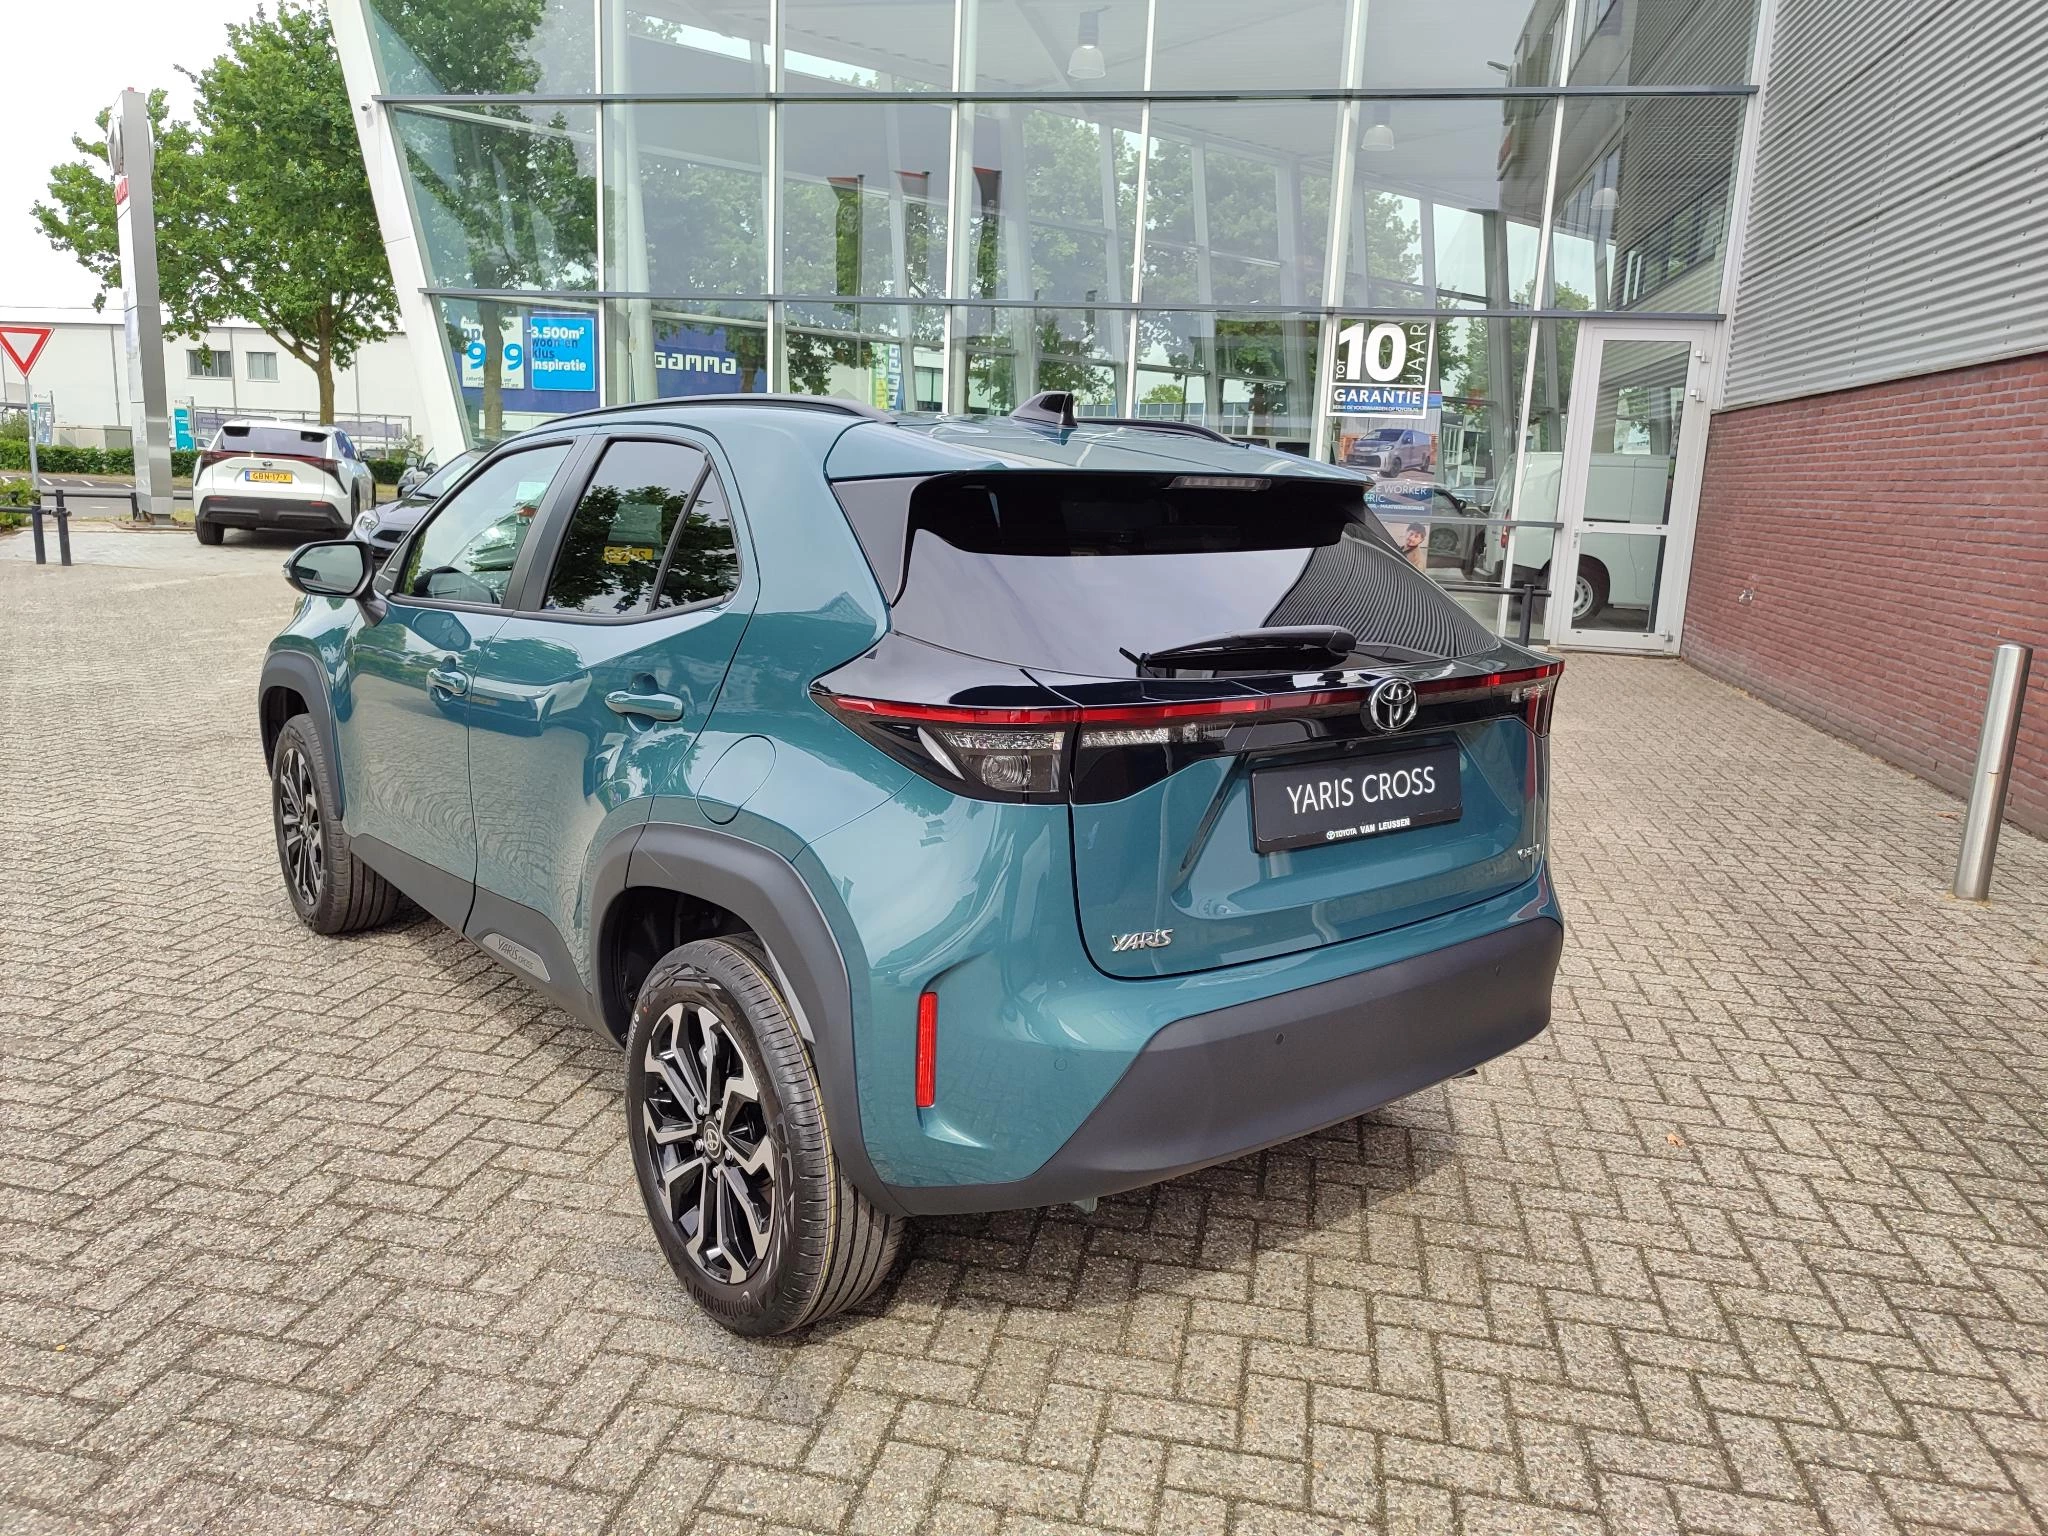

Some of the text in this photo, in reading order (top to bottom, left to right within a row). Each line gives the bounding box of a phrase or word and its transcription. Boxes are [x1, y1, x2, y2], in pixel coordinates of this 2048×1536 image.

[1339, 323, 1406, 382] 10
[1405, 324, 1427, 383] JAAR
[532, 359, 587, 372] inspiratie
[1336, 360, 1346, 379] TOT
[1334, 388, 1421, 404] GARANTIE
[1384, 485, 1427, 495] WORKER
[1286, 766, 1436, 815] YARIS CROSS
[1335, 817, 1410, 838] TOYOTA VAN LEUSSEN
